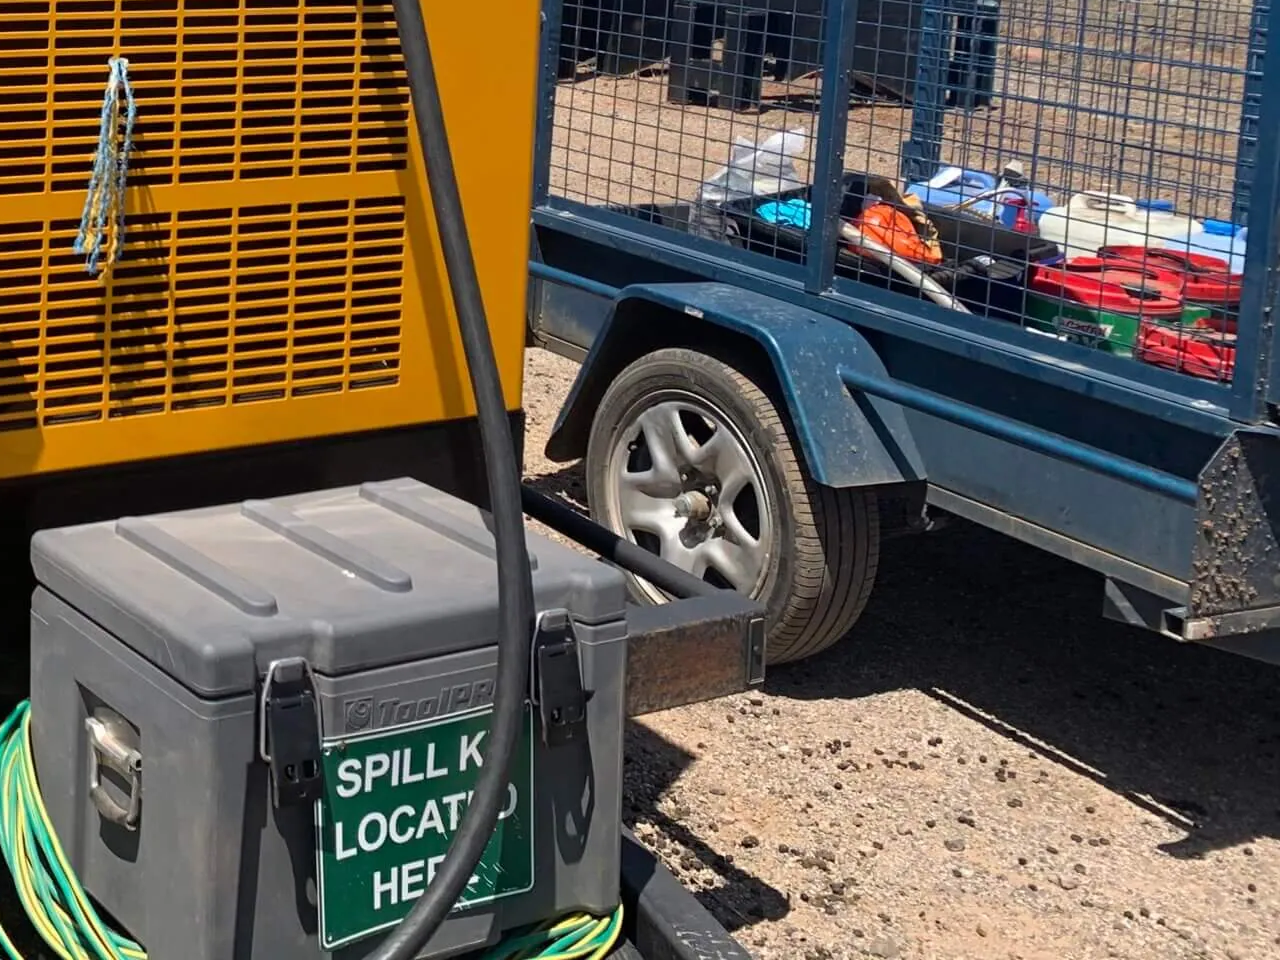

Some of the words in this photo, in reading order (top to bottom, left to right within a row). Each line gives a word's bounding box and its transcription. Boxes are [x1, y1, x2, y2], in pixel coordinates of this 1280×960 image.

[378, 678, 497, 727] ToolPR
[336, 742, 448, 798] SPILL
[335, 782, 518, 861] LOCATD
